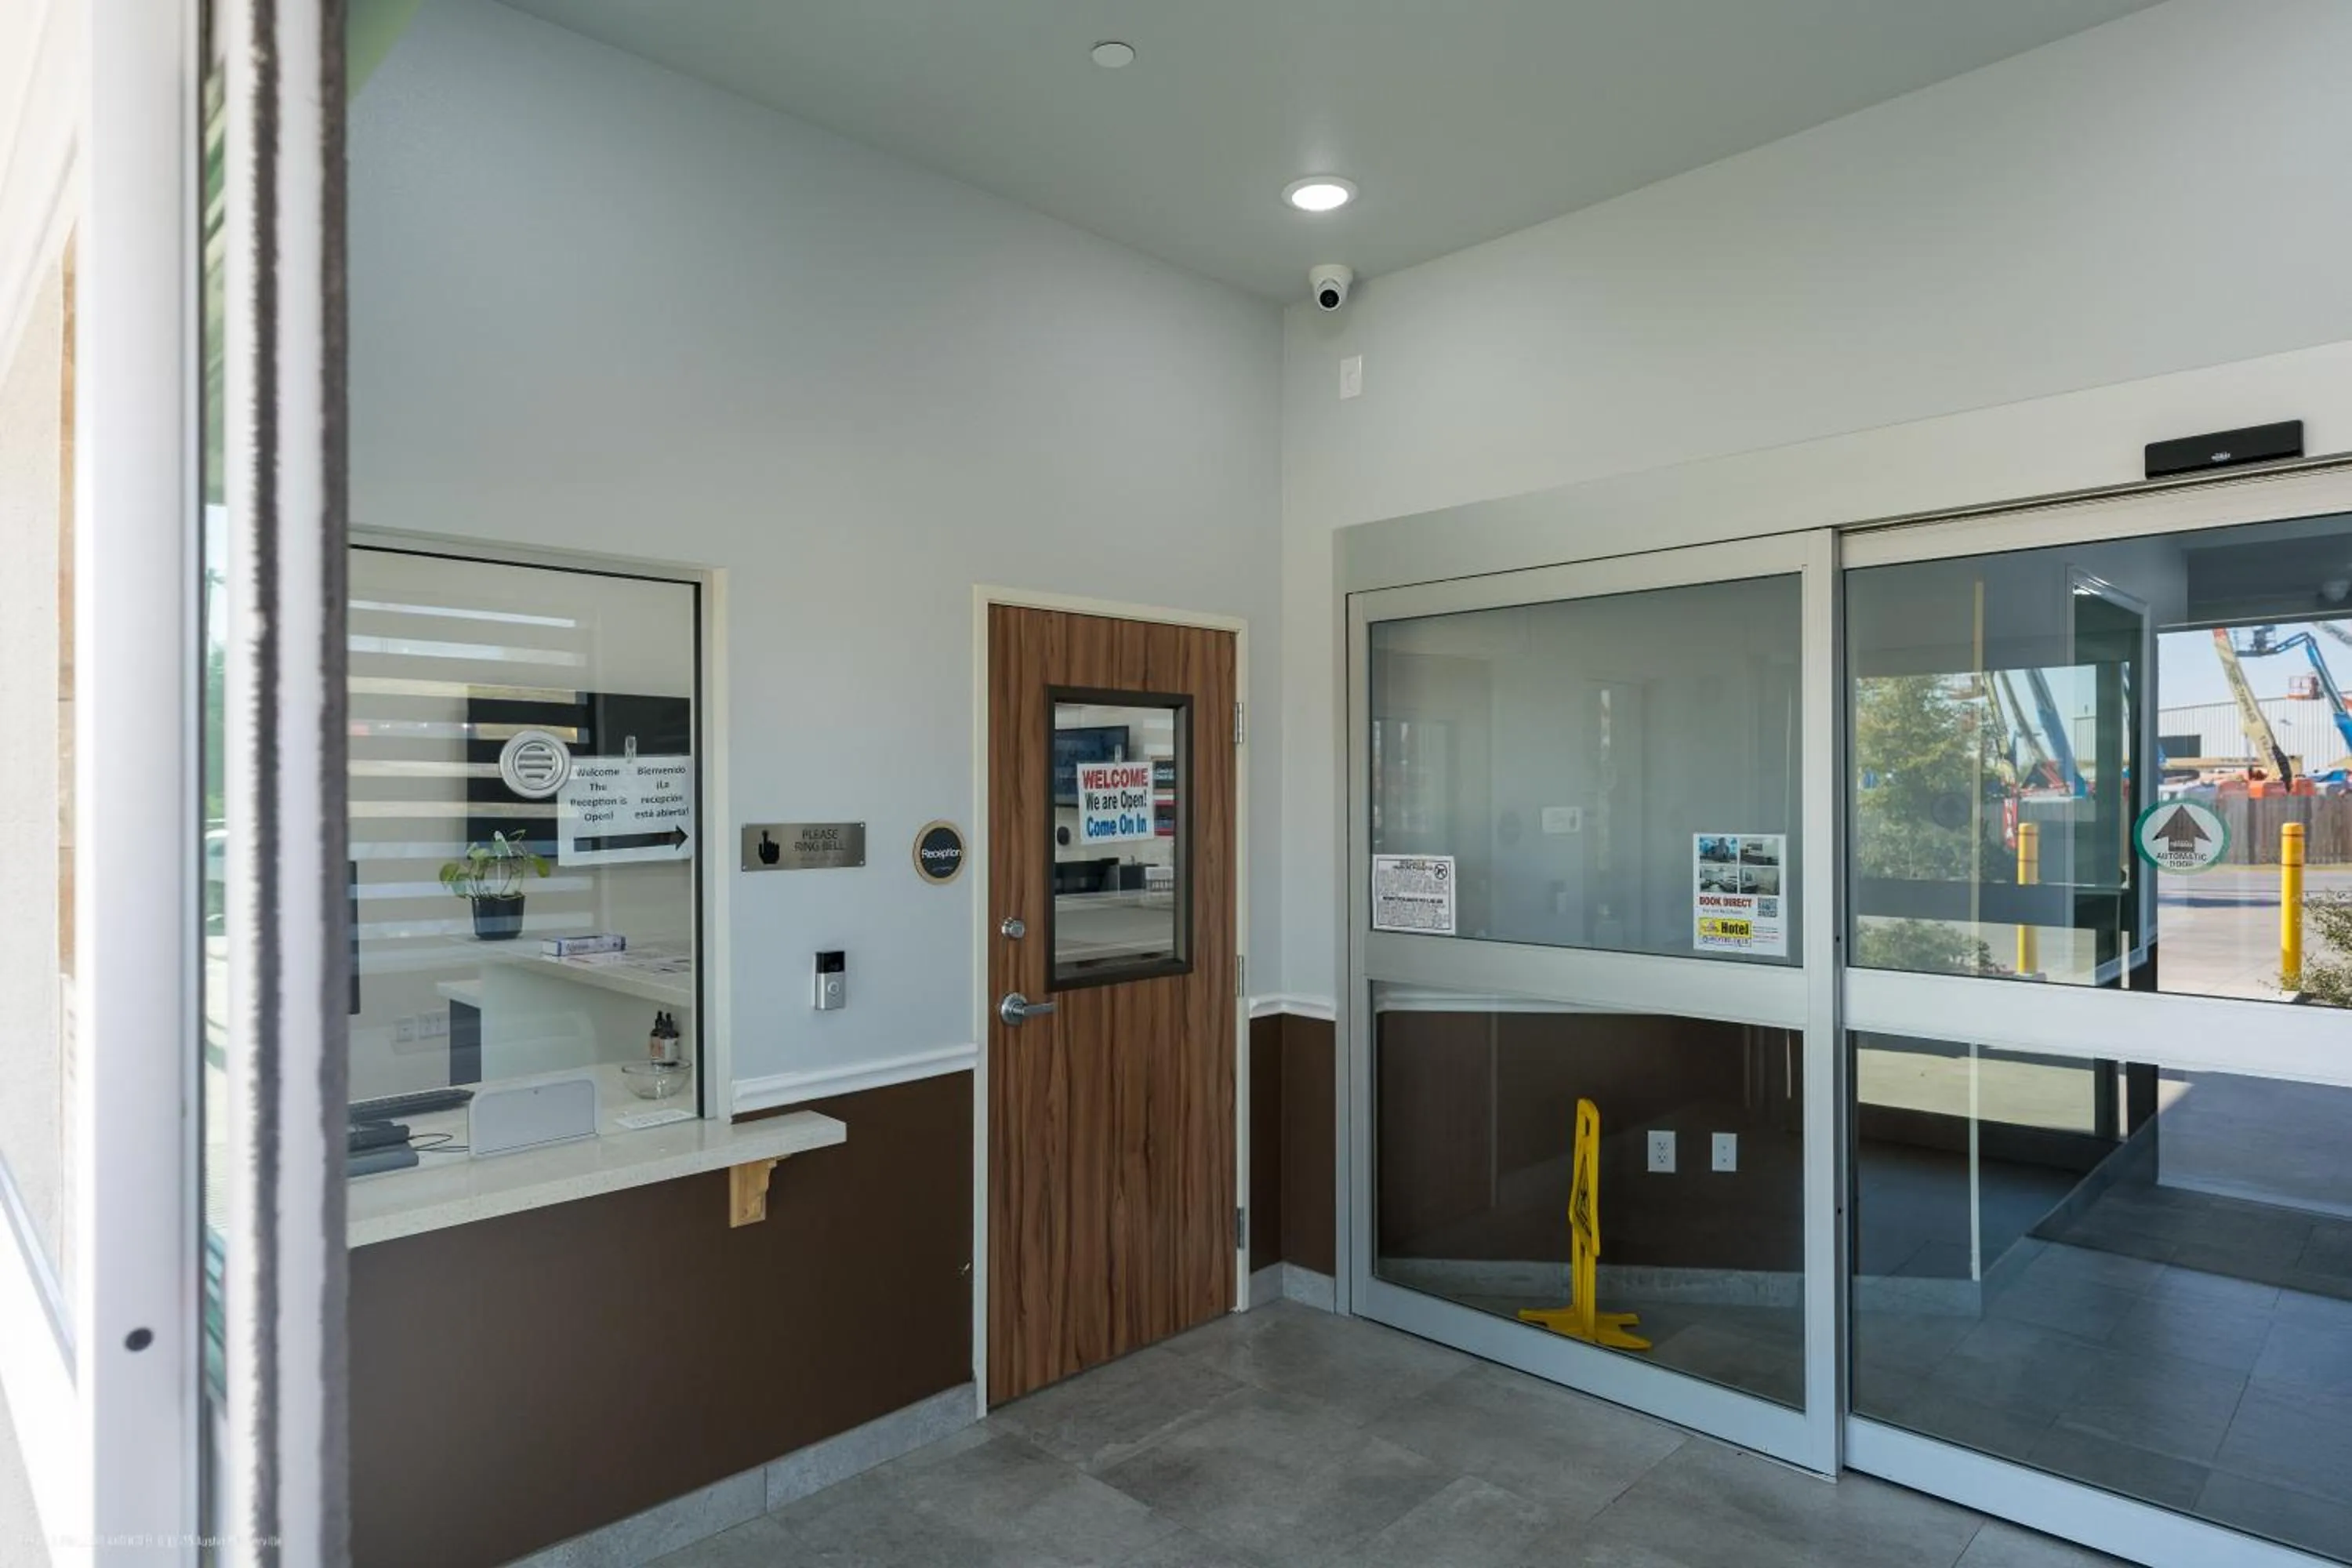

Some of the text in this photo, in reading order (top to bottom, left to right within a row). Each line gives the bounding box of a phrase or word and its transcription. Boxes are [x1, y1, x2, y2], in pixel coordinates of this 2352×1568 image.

[576, 768, 620, 777] Welcome
[637, 766, 686, 776] Bienvenido
[1082, 768, 1149, 789] WELCOME
[590, 782, 607, 792] The
[570, 798, 617, 808] Reception
[1085, 789, 1147, 812] We are Open!
[583, 812, 614, 823] Open!
[634, 809, 654, 819] está
[1087, 813, 1147, 837] Come On In
[802, 829, 839, 839] PLEASE
[794, 840, 845, 851] RING BELL
[921, 848, 960, 860] Reception
[2157, 852, 2209, 862] AUTOMATIC
[1699, 896, 1753, 908] BOOK DIRECT
[1721, 921, 1749, 935] Hotel
